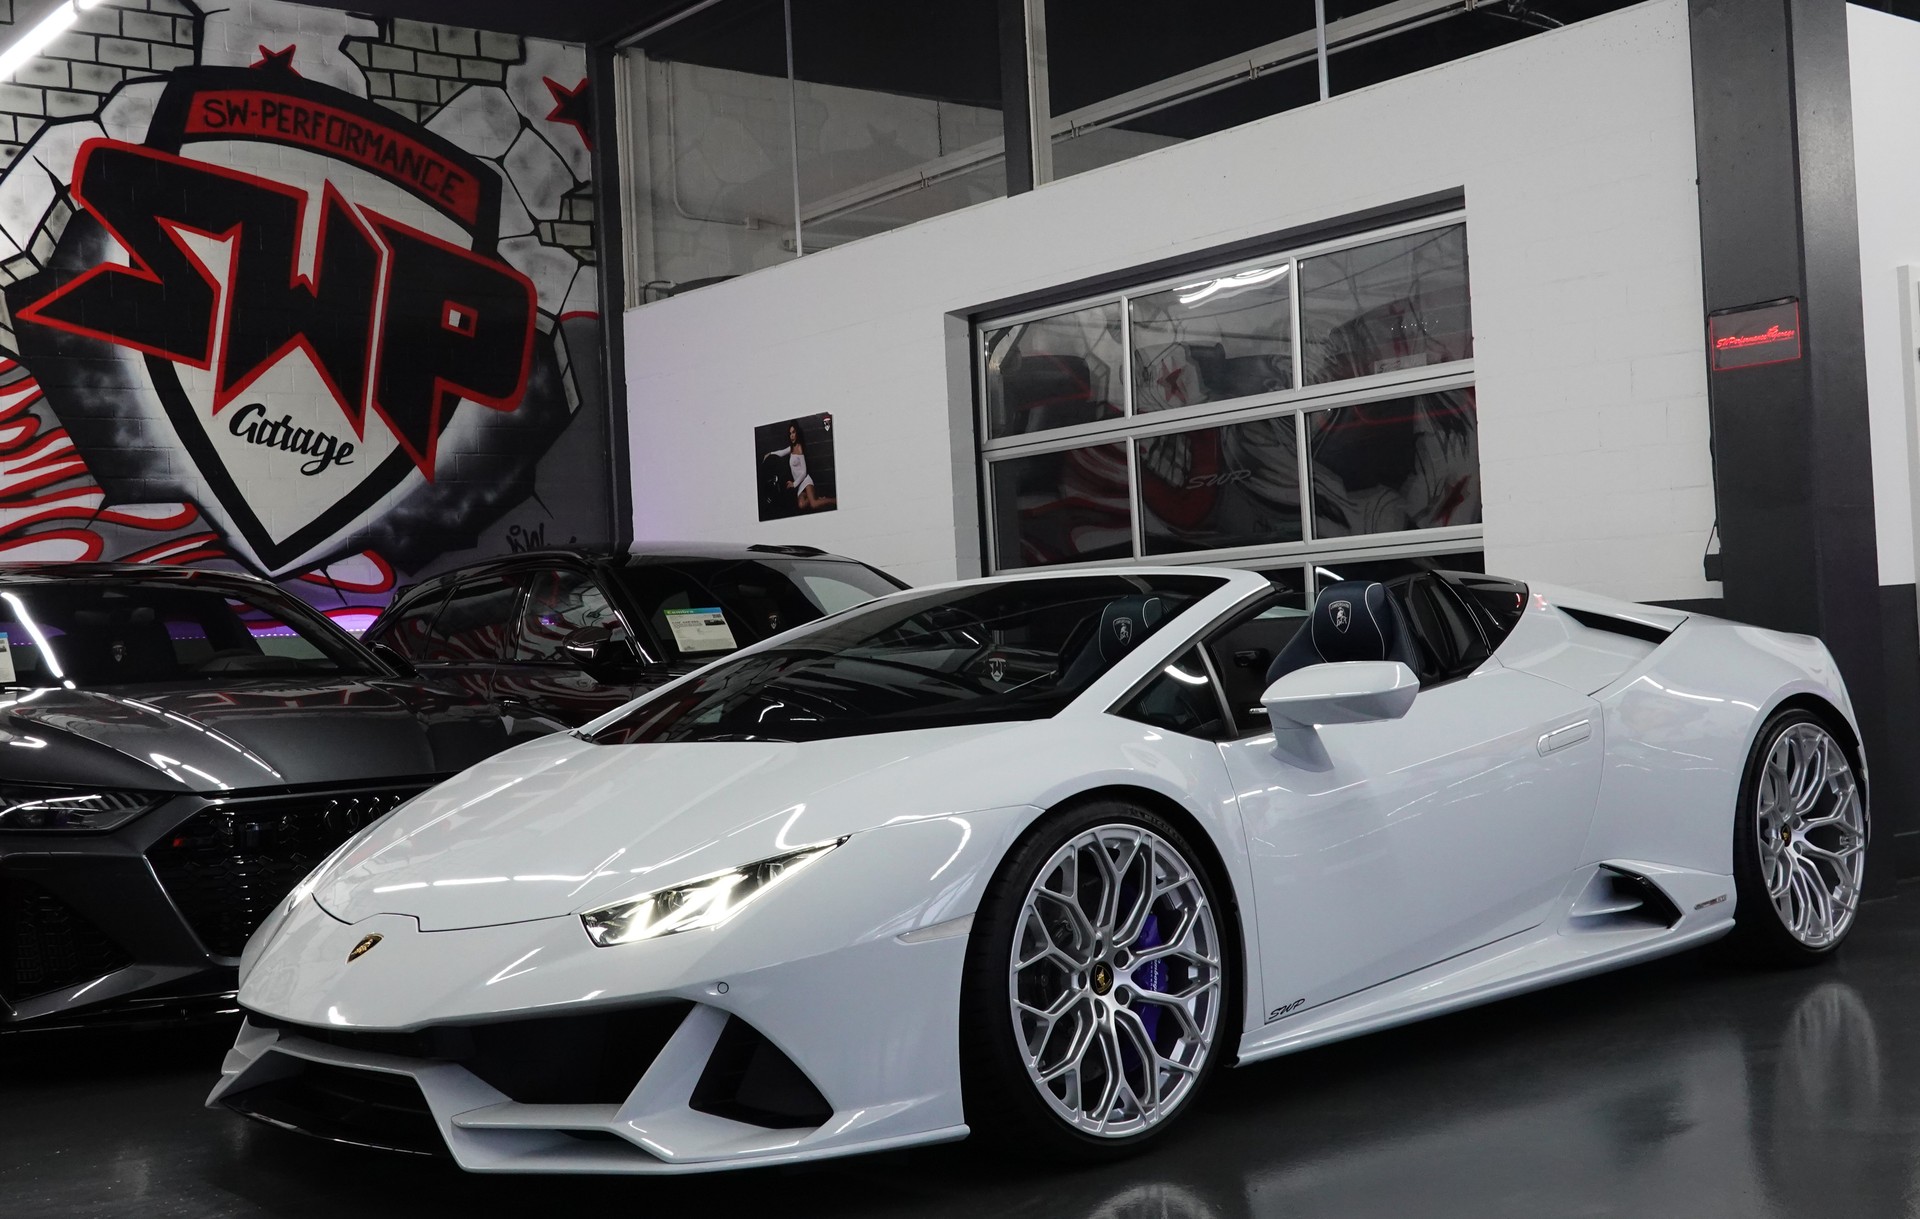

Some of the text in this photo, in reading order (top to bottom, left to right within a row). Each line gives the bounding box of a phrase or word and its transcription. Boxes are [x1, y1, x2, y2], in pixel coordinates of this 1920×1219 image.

[203, 99, 465, 204] SW-PERFORMANCE
[15, 138, 537, 485] SWP
[229, 403, 354, 476] Garage
[1268, 998, 1306, 1020] SWP
